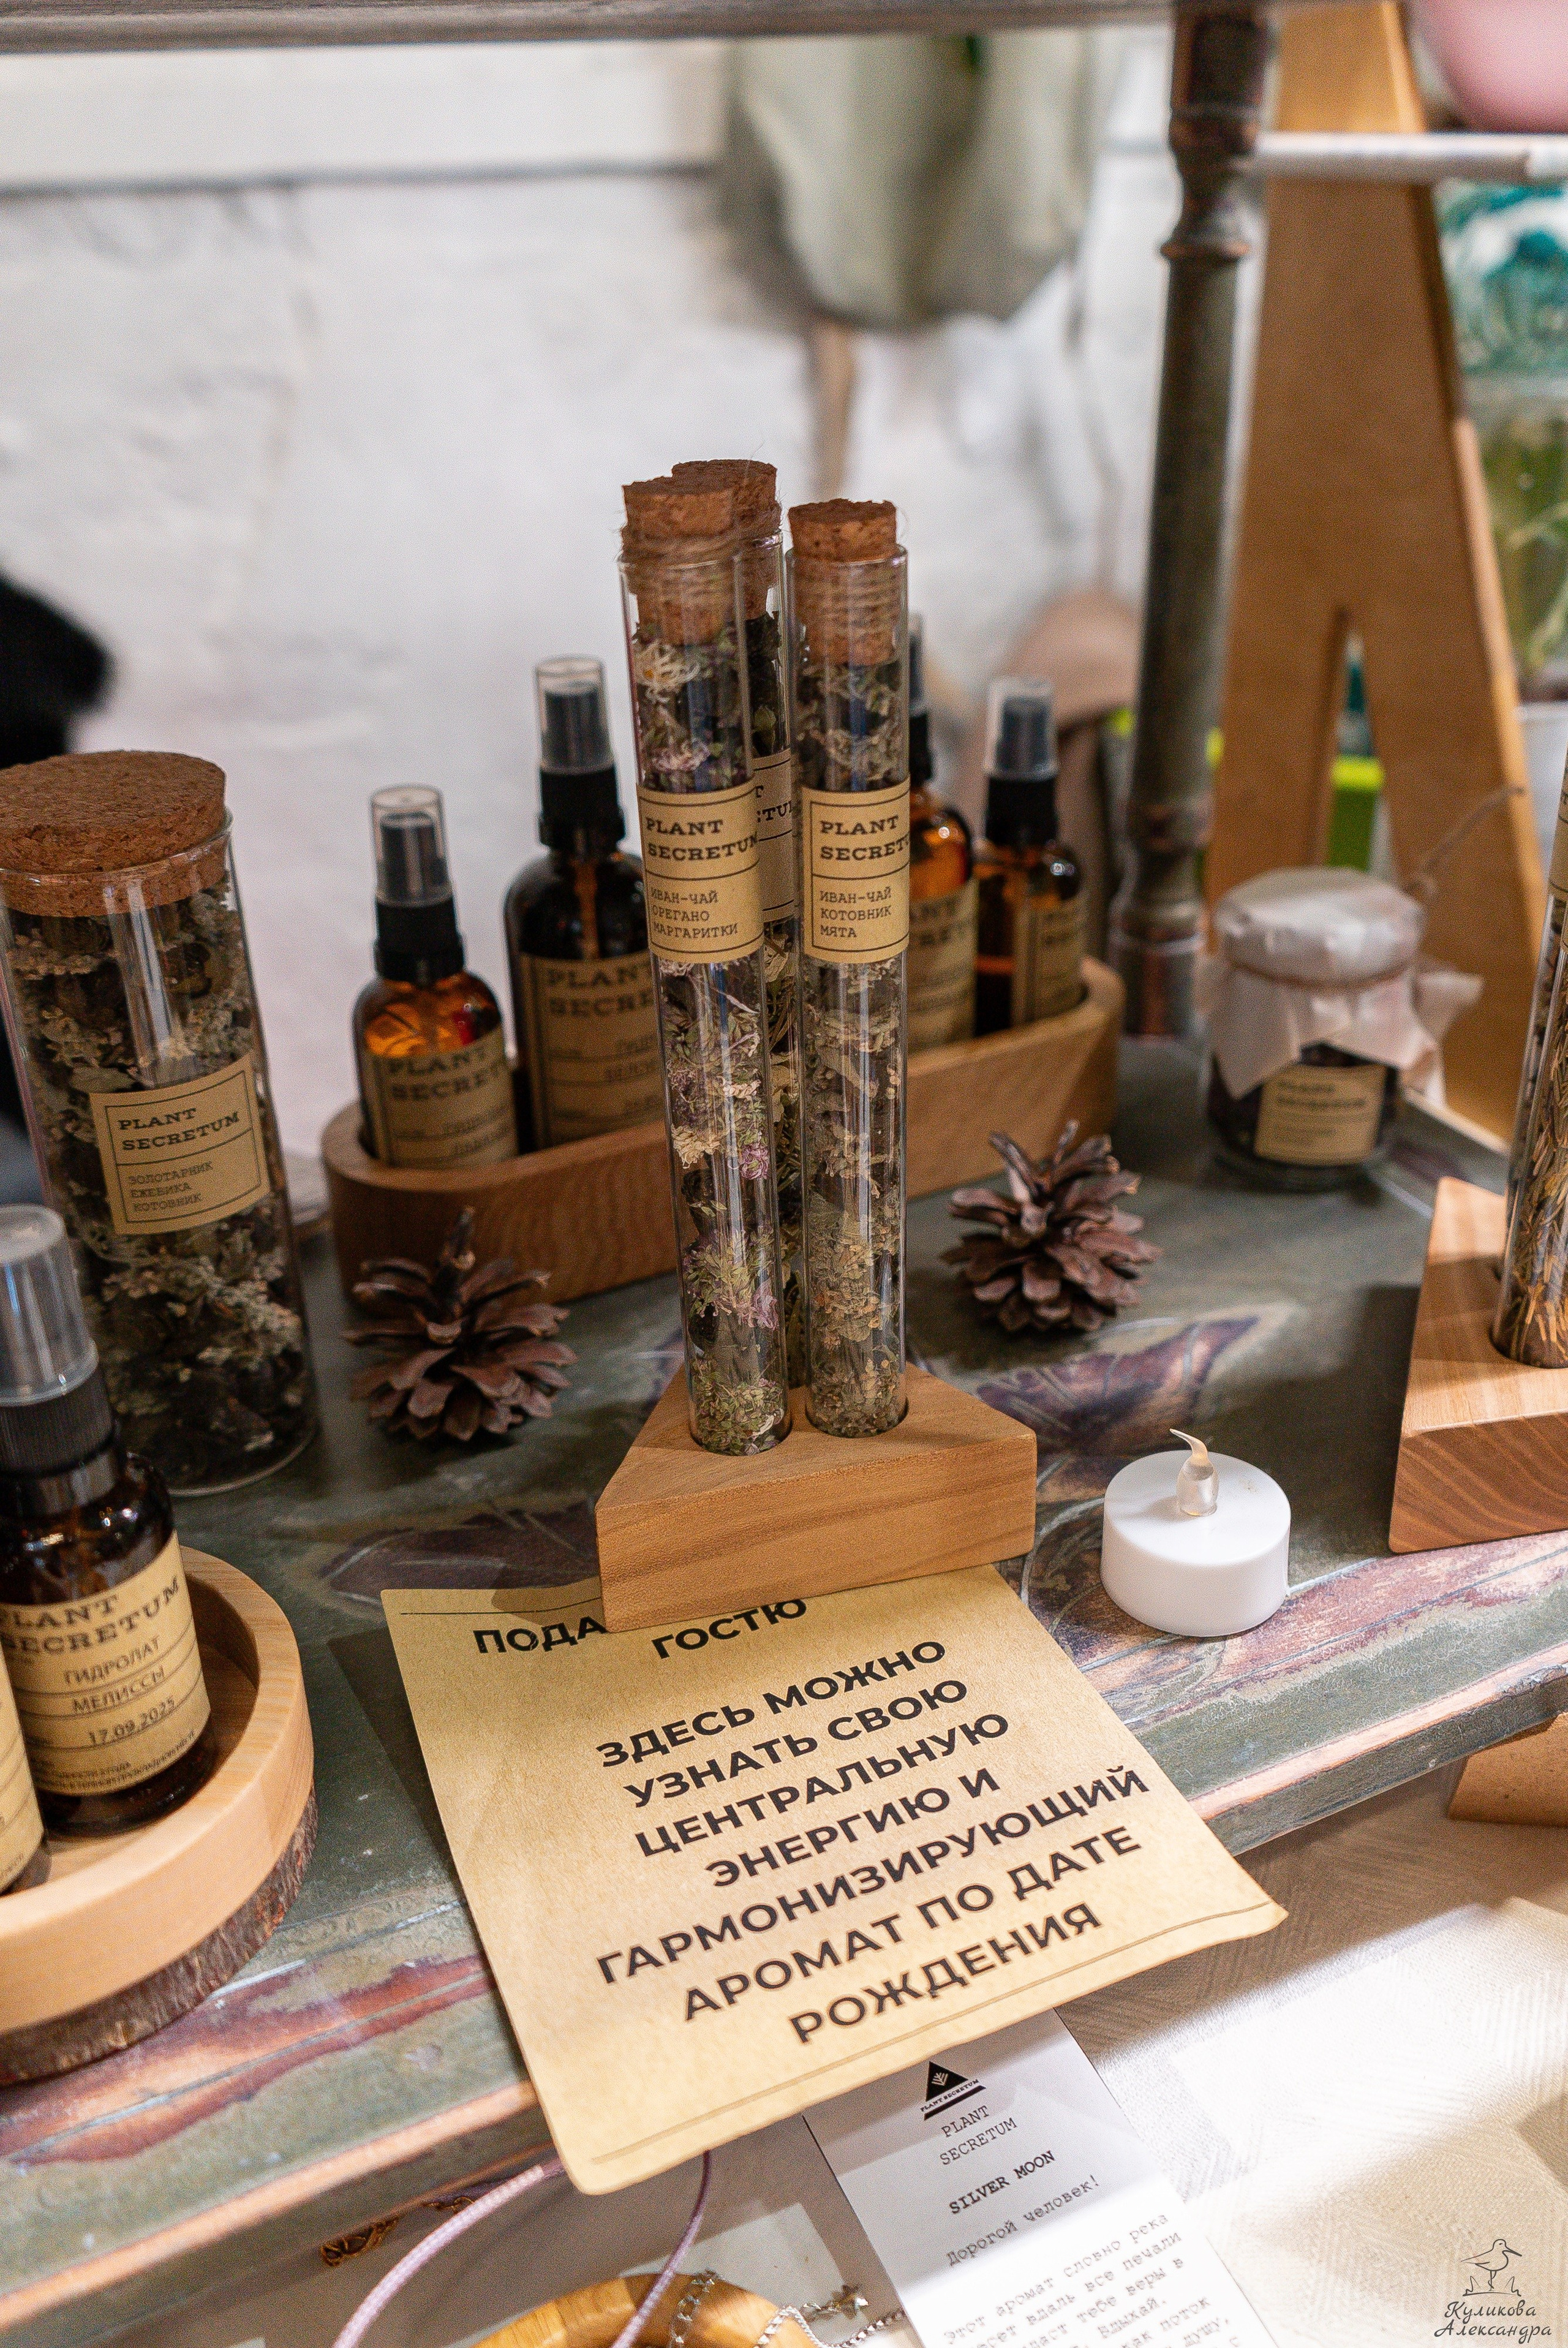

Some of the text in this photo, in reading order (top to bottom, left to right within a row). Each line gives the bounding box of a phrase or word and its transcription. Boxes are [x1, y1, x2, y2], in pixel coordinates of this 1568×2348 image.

[646, 818, 723, 836] PLANT
[820, 815, 899, 836] PLANT
[650, 889, 719, 905] ИВАН-ЧАЙ
[651, 905, 710, 921] ОРЕГАНО
[820, 886, 891, 904] ИВАН-ЧАЙ
[820, 905, 892, 921] КОТОВНИК
[653, 924, 738, 939] МАРГАРИТКИ
[820, 925, 858, 938] МЯТА
[118, 1108, 197, 1131] PLANT
[123, 1111, 240, 1151] SECRETUM
[128, 1161, 214, 1186] ЗОЛОТАРНИК
[472, 1615, 608, 1654] ПОДА
[651, 1598, 807, 1659] ГОСТЮ
[63, 1634, 160, 1685] ГИДРОЛАТ
[72, 1665, 166, 1713] МЕЛИССЫ
[595, 1640, 946, 1768] ЗДЕСЬ МОЖНО
[623, 1678, 968, 1809] УЗНАТЬ СВОЮ
[635, 1713, 1009, 1858] ЦЕНТРАЛЬНУЮ
[705, 1769, 1001, 1888] ЭНЕРГИЮ И
[595, 1765, 1150, 1985] ГАРМОНИЗИРУЮЩИЙ
[683, 1825, 1143, 2023] АРОМАТ ПО ДАТЕ
[788, 1902, 1103, 2045] РОЖДЕНИЯ
[920, 2078, 979, 2112] PLANT SECRETUM
[940, 2117, 1017, 2165] SECRETUM
[941, 2105, 989, 2137] PLANT
[949, 2150, 1055, 2214] SILVER MOON
[946, 2174, 1100, 2267] Дорогой человек!
[944, 2214, 1168, 2345] Этот аромат словно река
[1025, 2293, 1076, 2325] вдаль
[1084, 2270, 1115, 2292] все
[1122, 2232, 1182, 2271] печали
[1076, 2295, 1117, 2323] тебе
[1125, 2267, 1167, 2297] веры
[1172, 2257, 1184, 2269] в
[1097, 2297, 1166, 2339] Вдыхай.
[1159, 2296, 1211, 2332] поток
[1183, 2317, 1230, 2347] душу,
